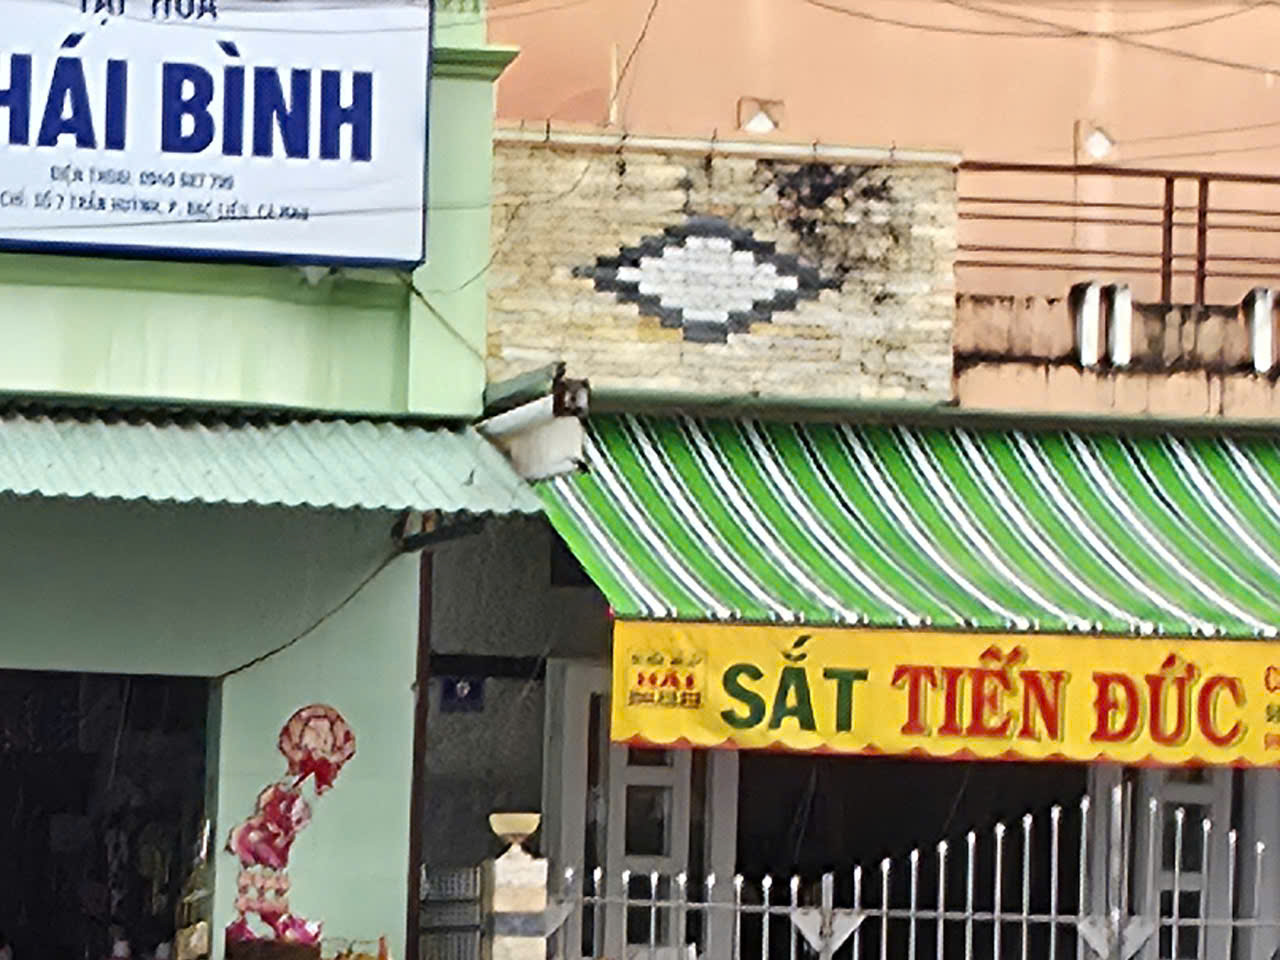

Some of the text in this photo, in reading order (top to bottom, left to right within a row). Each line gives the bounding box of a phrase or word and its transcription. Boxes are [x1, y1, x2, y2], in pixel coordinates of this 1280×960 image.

[160, 39, 374, 163] BÌNH
[720, 633, 869, 733] SẮT
[1090, 652, 1248, 748] ĐỨC
